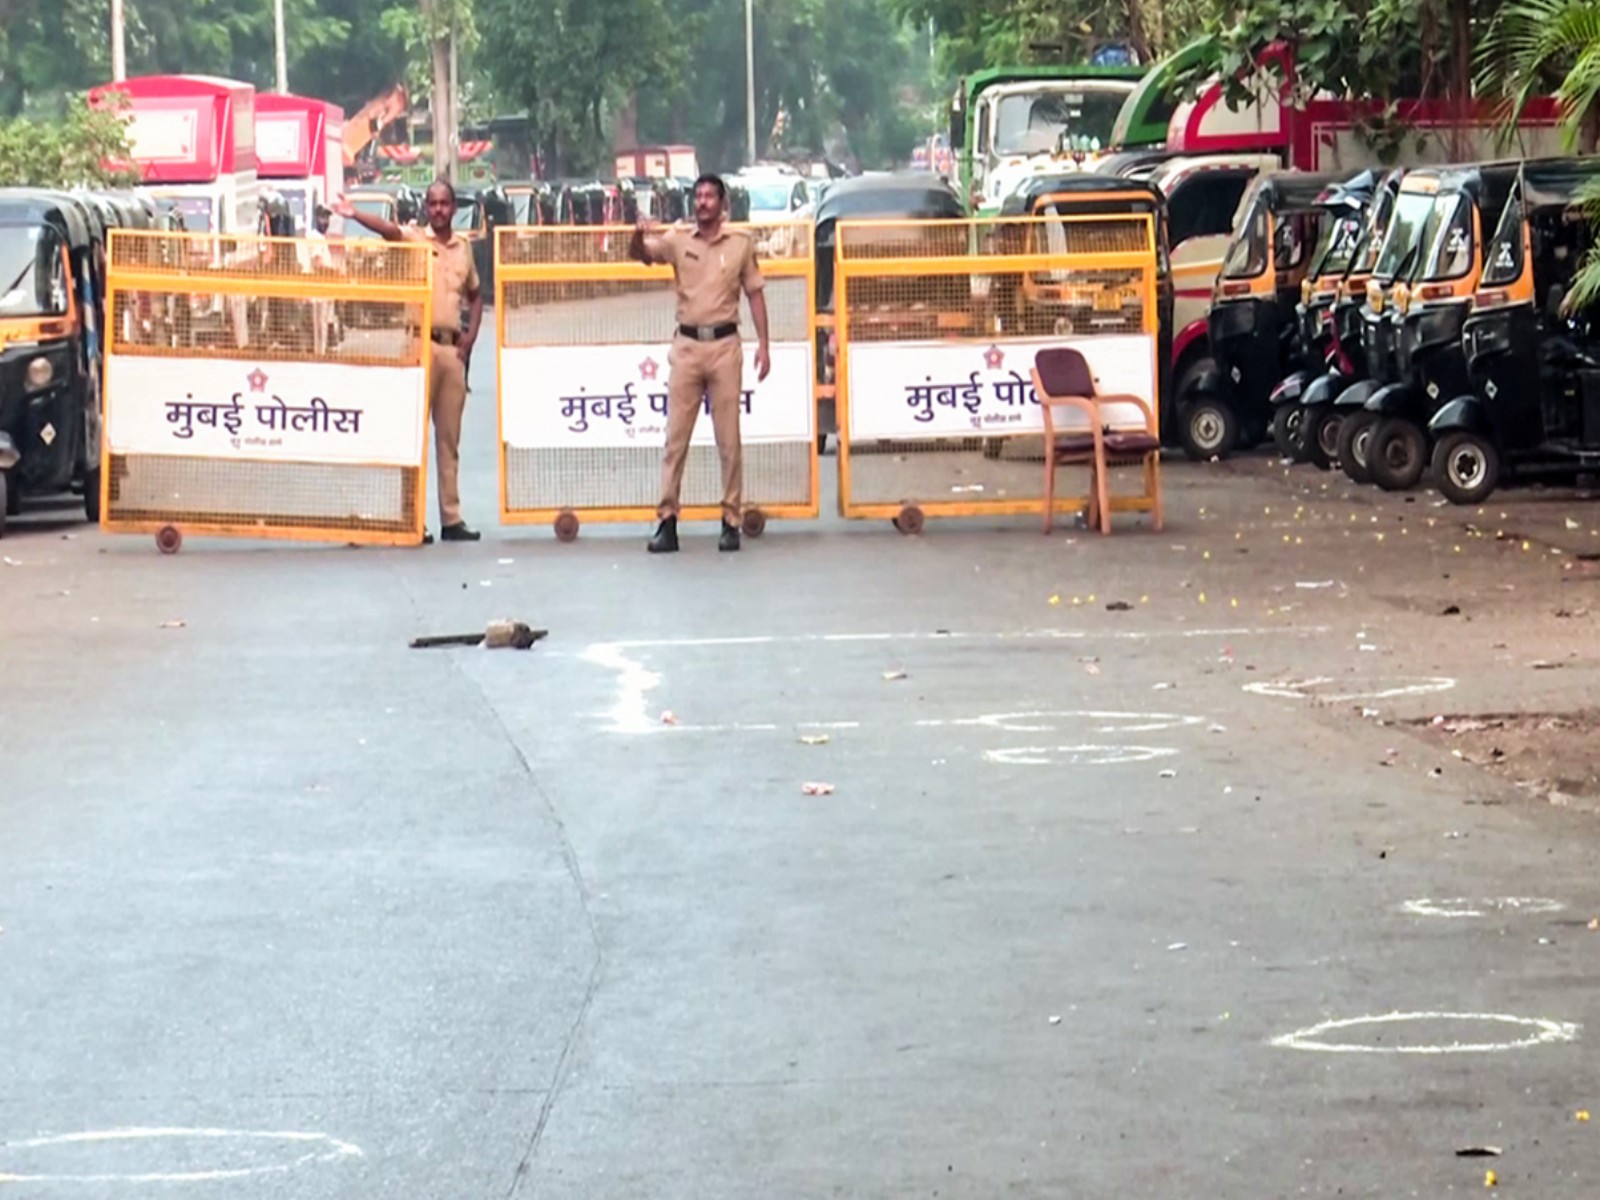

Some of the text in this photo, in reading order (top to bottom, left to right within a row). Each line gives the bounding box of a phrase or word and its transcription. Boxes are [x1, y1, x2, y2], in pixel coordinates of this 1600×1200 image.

[165, 393, 363, 439] मुंबई पोलीस
[559, 383, 637, 433] मुंबई
[905, 371, 983, 422] मुंबई
